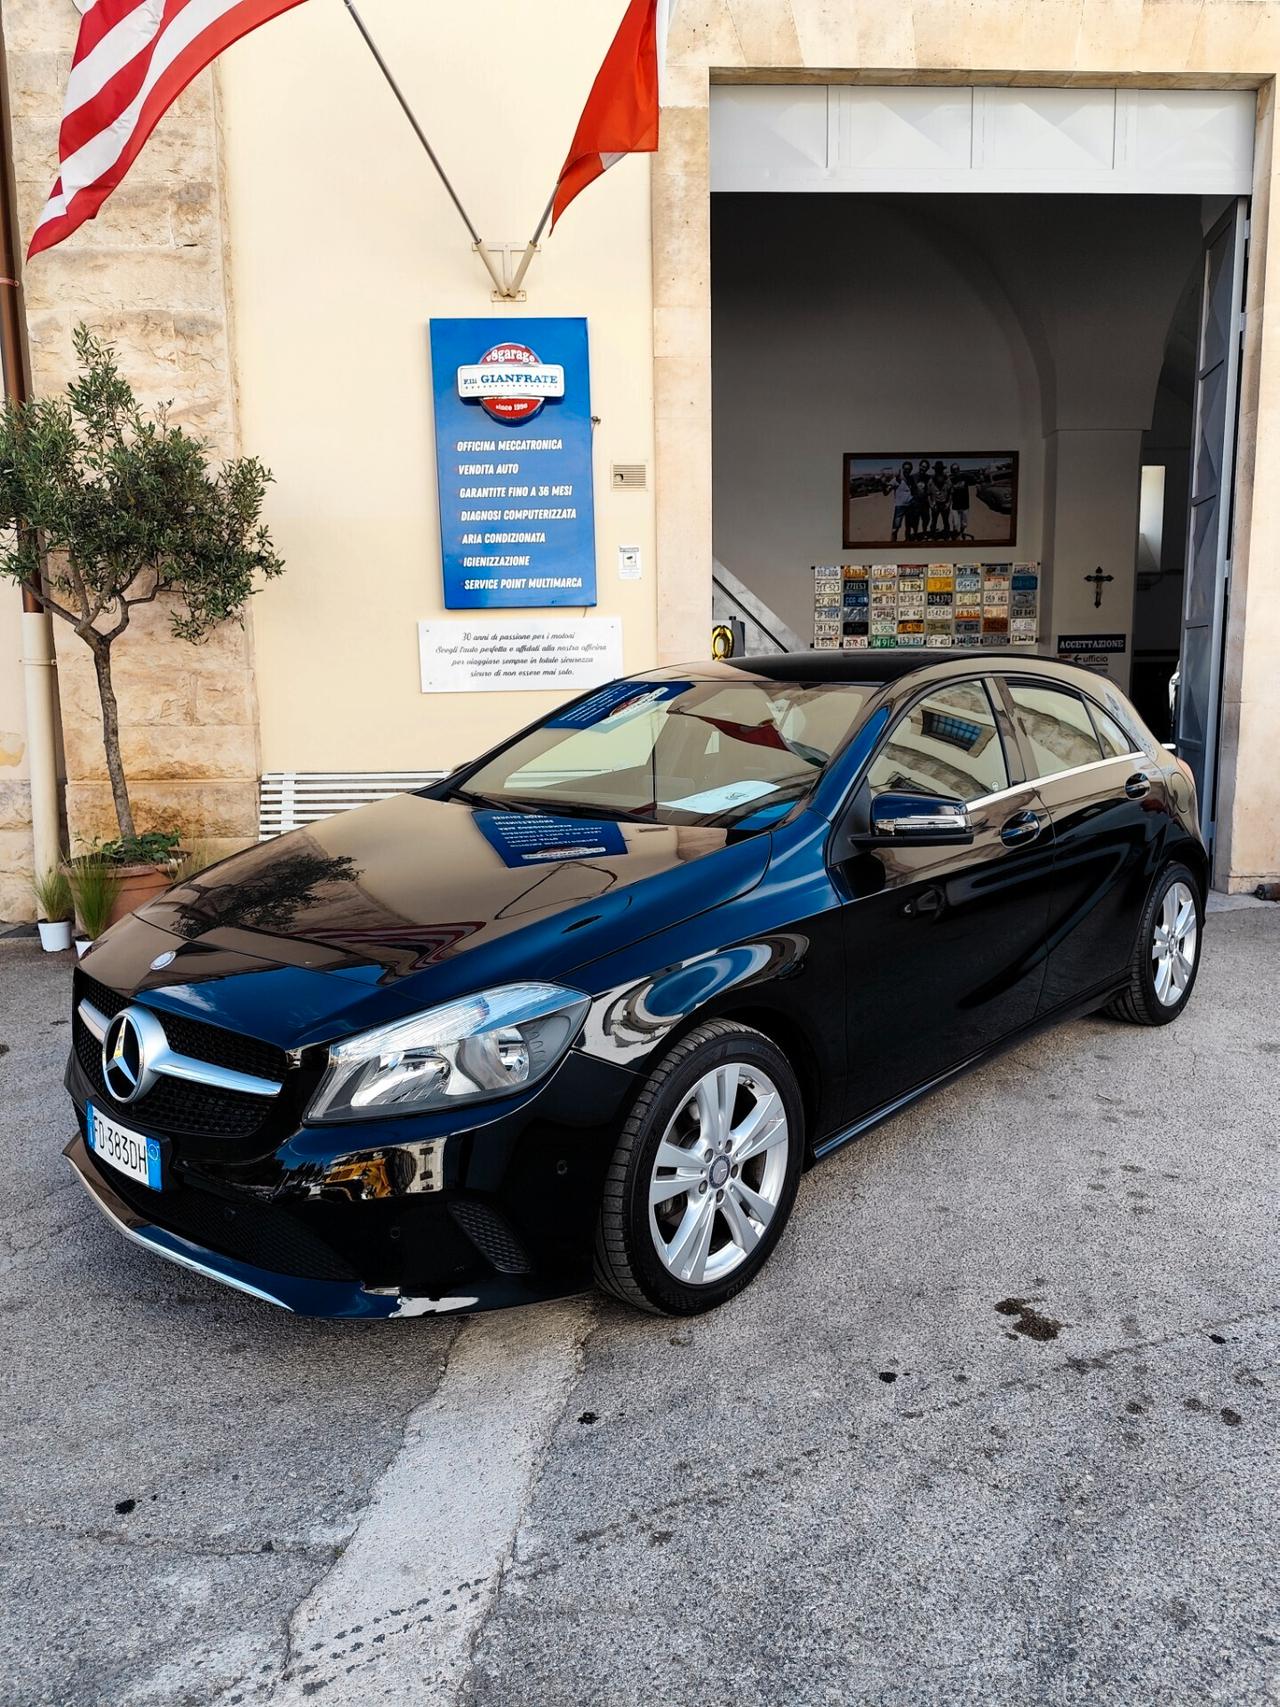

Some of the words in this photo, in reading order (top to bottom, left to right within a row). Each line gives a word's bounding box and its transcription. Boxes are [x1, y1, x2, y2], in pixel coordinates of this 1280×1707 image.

[480, 374, 558, 384] GIANFRATE
[495, 403, 513, 411] since
[457, 441, 495, 452] OFFICINA
[498, 439, 563, 451] MECCATRONICA
[458, 464, 494, 475] VENDITA
[496, 463, 519, 474] AUTO
[460, 487, 506, 498] GARANTITE
[508, 486, 528, 497] FINO
[530, 486, 537, 497] A
[538, 486, 549, 496] 36
[551, 485, 572, 496] MESI
[461, 510, 501, 521] DIAGNOSI
[503, 508, 577, 520] COMPUTERIZZATA
[462, 533, 482, 544] ARIA
[484, 532, 546, 544] CONDIZIONATA
[463, 556, 531, 567] IGIENIZZAZIONE
[464, 579, 499, 590] SERVICE
[500, 578, 527, 589] POINT
[528, 577, 582, 588] MULTIMARCA
[473, 633, 489, 641] anni
[490, 633, 498, 641] di
[499, 632, 530, 641] passione
[551, 632, 575, 640] motori
[479, 645, 507, 654] perfetta
[515, 644, 540, 653] affidati
[542, 644, 555, 652] alla
[557, 644, 579, 652] nostra
[581, 643, 607, 652] officina
[1059, 640, 1125, 649] ACCETTAZIONE
[451, 659, 464, 667] per
[466, 658, 500, 667] viaggiare
[502, 658, 528, 666] sempre
[530, 656, 537, 664] in
[538, 656, 558, 664] totale
[560, 656, 594, 664] sicurezza
[1083, 654, 1109, 663] ufficio
[494, 669, 501, 677] di
[542, 668, 557, 676] mai
[107, 1126, 147, 1175] 383DH
